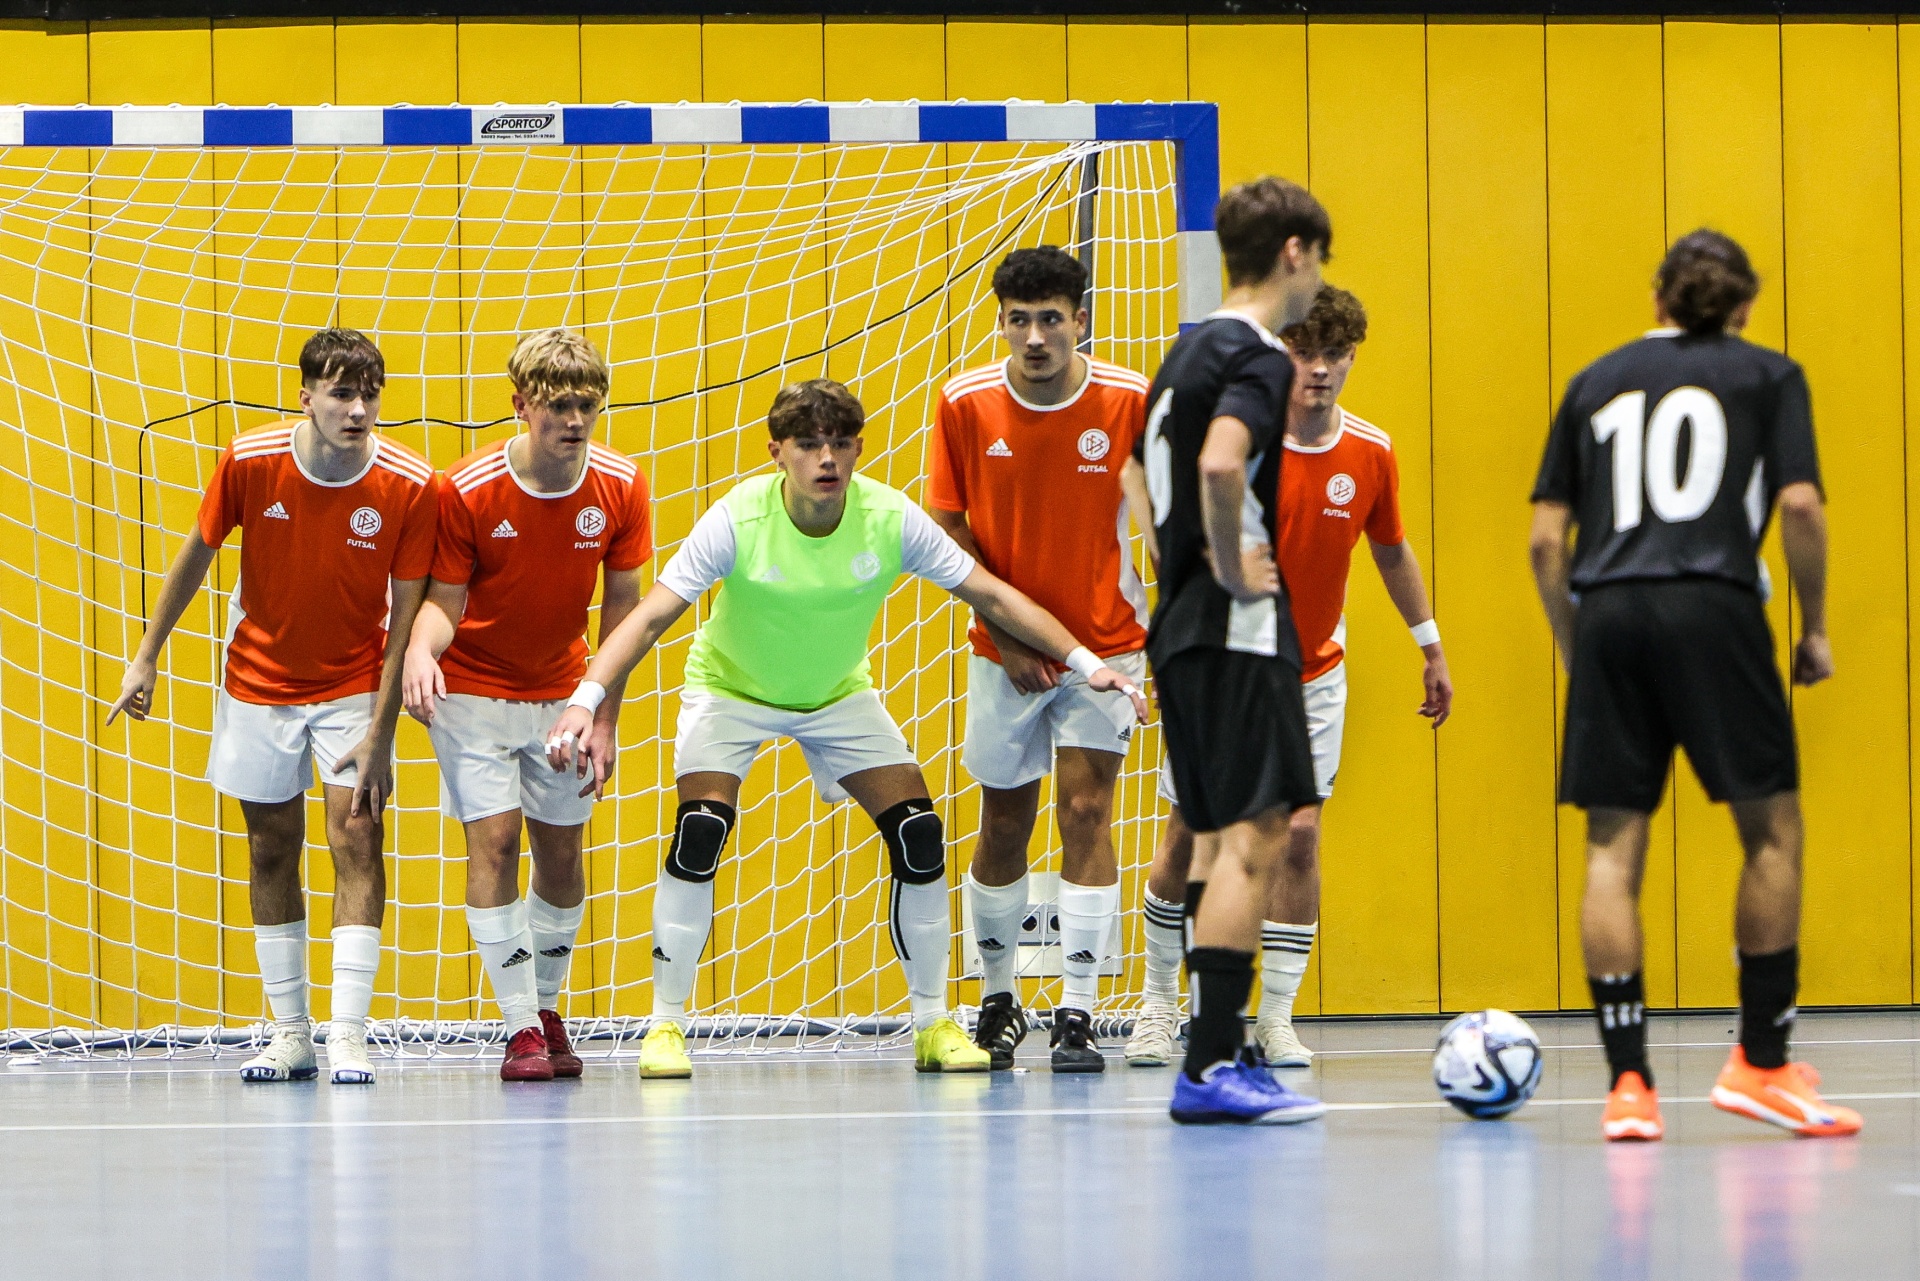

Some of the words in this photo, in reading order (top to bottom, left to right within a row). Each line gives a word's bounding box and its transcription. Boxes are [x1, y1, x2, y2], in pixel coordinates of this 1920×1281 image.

[492, 118, 543, 129] SPORTCO
[1590, 385, 1729, 533] 10
[1077, 464, 1109, 473] FUTSAL
[263, 510, 290, 520] adidas
[1322, 507, 1352, 519] FUTSAL
[491, 530, 518, 538] adidas
[346, 538, 377, 550] FUTSAL
